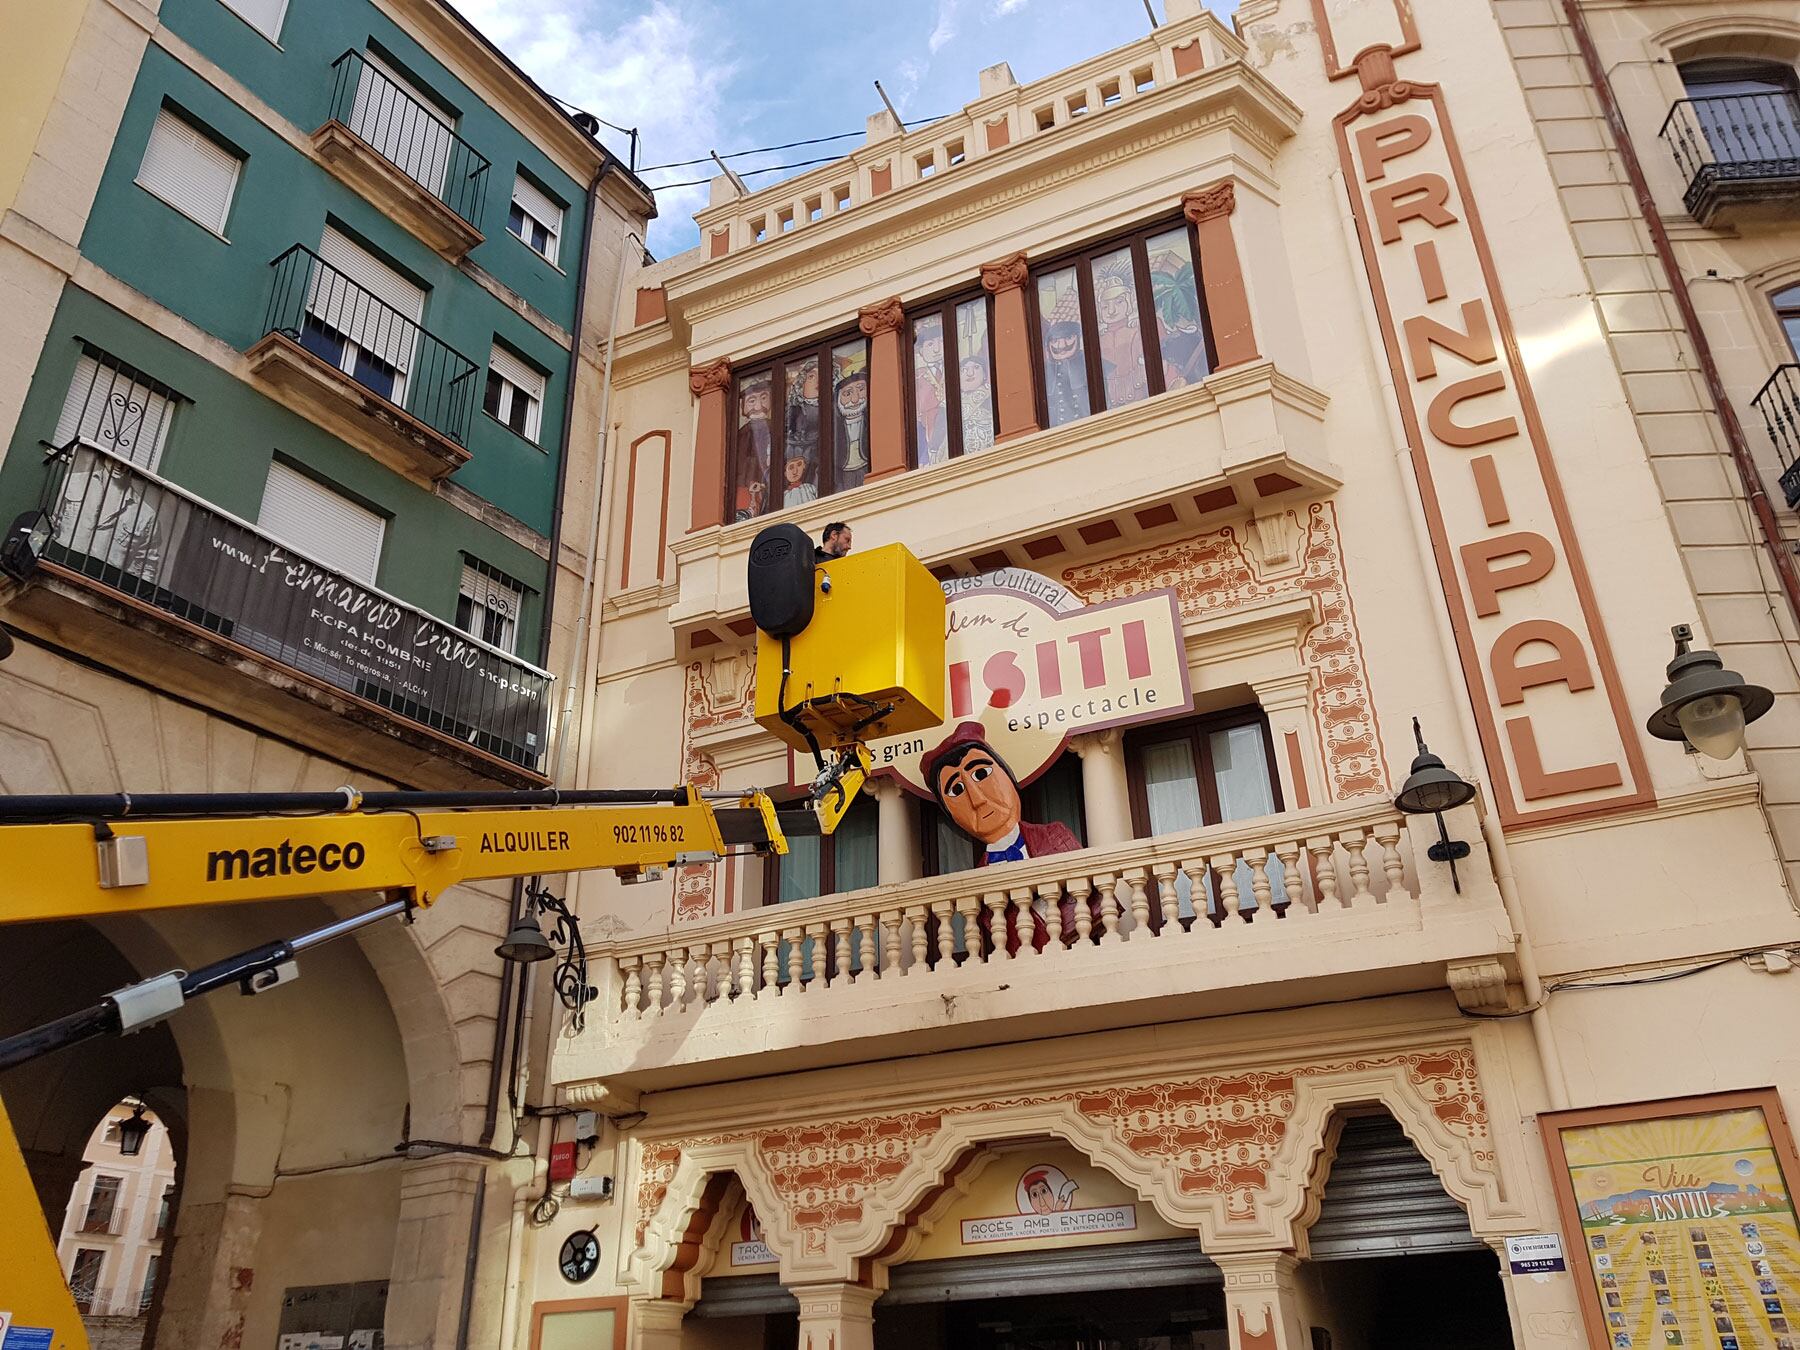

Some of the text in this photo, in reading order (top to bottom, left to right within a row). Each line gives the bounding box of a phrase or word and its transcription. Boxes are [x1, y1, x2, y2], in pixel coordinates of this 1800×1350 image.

[1355, 114, 1623, 801] PRINCIPAL
[941, 569, 1068, 607] erés Cultural
[310, 608, 432, 672] ROPA HOMBRE
[945, 610, 1030, 640] lem de
[948, 619, 1152, 719] ISITI
[883, 738, 924, 762] gran
[1007, 687, 1157, 732] espectacle
[206, 838, 365, 882] mateco
[480, 831, 570, 853] ALQUILER
[1024, 1217, 1050, 1229] AMB
[1060, 1211, 1125, 1226] ENTRADA
[1649, 1190, 1713, 1221] ESTIU
